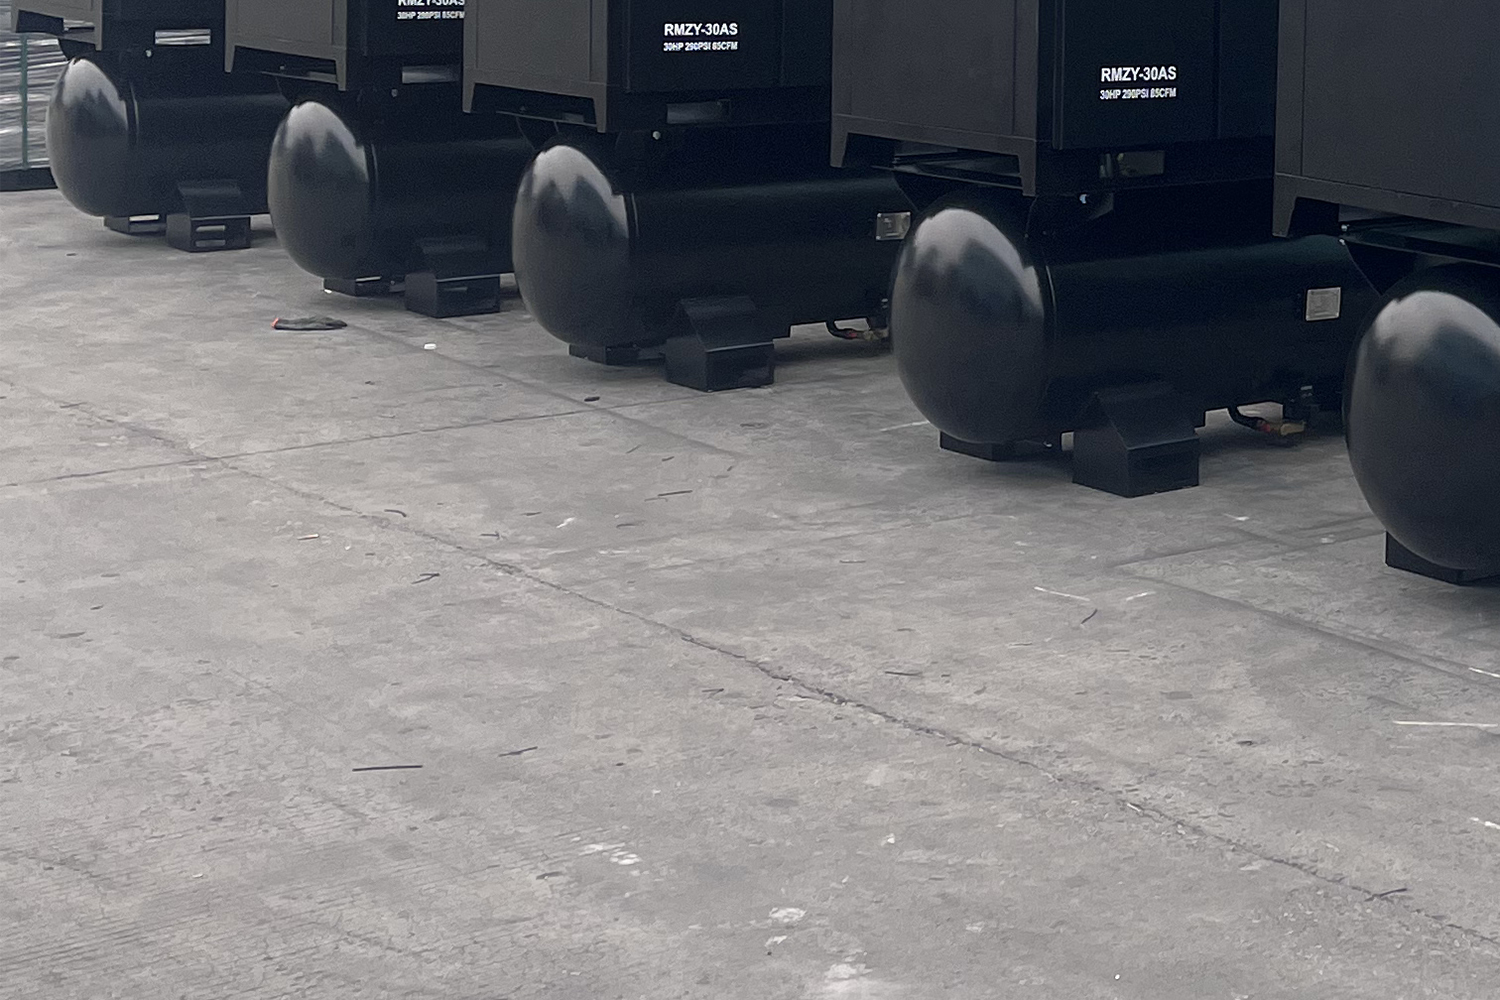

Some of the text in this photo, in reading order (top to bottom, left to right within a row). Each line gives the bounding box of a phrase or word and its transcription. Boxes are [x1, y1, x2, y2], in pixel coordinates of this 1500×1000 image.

[664, 22, 738, 36] RMZY-30AS
[1100, 65, 1177, 82] RMZY-30AS
[1099, 89, 1121, 100] 30HP
